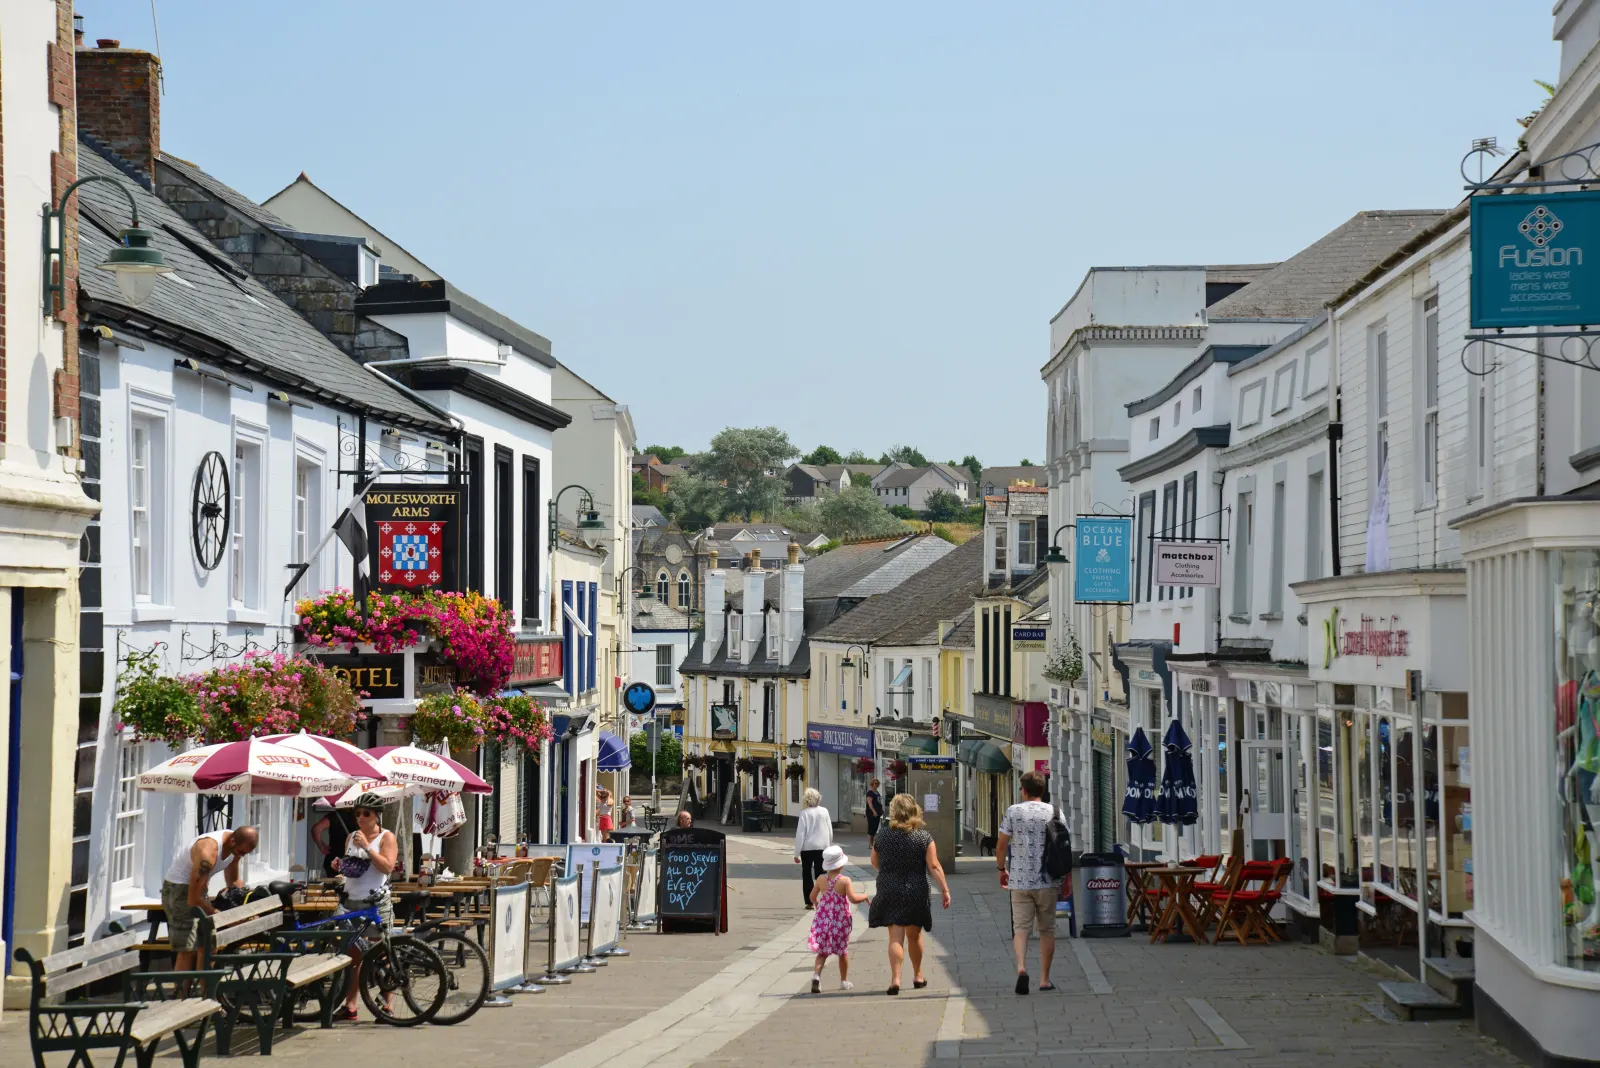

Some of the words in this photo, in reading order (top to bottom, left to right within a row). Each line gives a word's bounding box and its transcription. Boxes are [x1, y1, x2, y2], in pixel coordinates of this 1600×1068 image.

[1499, 245, 1583, 268] Fusion
[1509, 270, 1541, 280] ladies
[1544, 270, 1571, 279] wear
[1510, 282, 1540, 291] mens
[1543, 281, 1570, 290] wear
[1509, 292, 1571, 302] accessories
[366, 493, 456, 505] MOLESWORTH
[392, 507, 430, 517] ARMS
[1083, 525, 1122, 534] OCEAN
[1083, 535, 1122, 547] BLUE
[1161, 552, 1214, 561] matchbox
[1083, 567, 1121, 575] CLOTHING
[1174, 562, 1200, 570] Clothing
[1170, 571, 1204, 579] Accessories
[259, 755, 309, 766] TRIBUTE
[393, 757, 439, 770] TRIBUTE
[411, 773, 445, 786] Earned
[666, 866, 681, 879] ALL
[685, 866, 707, 881] DAY
[667, 877, 703, 895] EVERY
[669, 891, 696, 911] DAY
